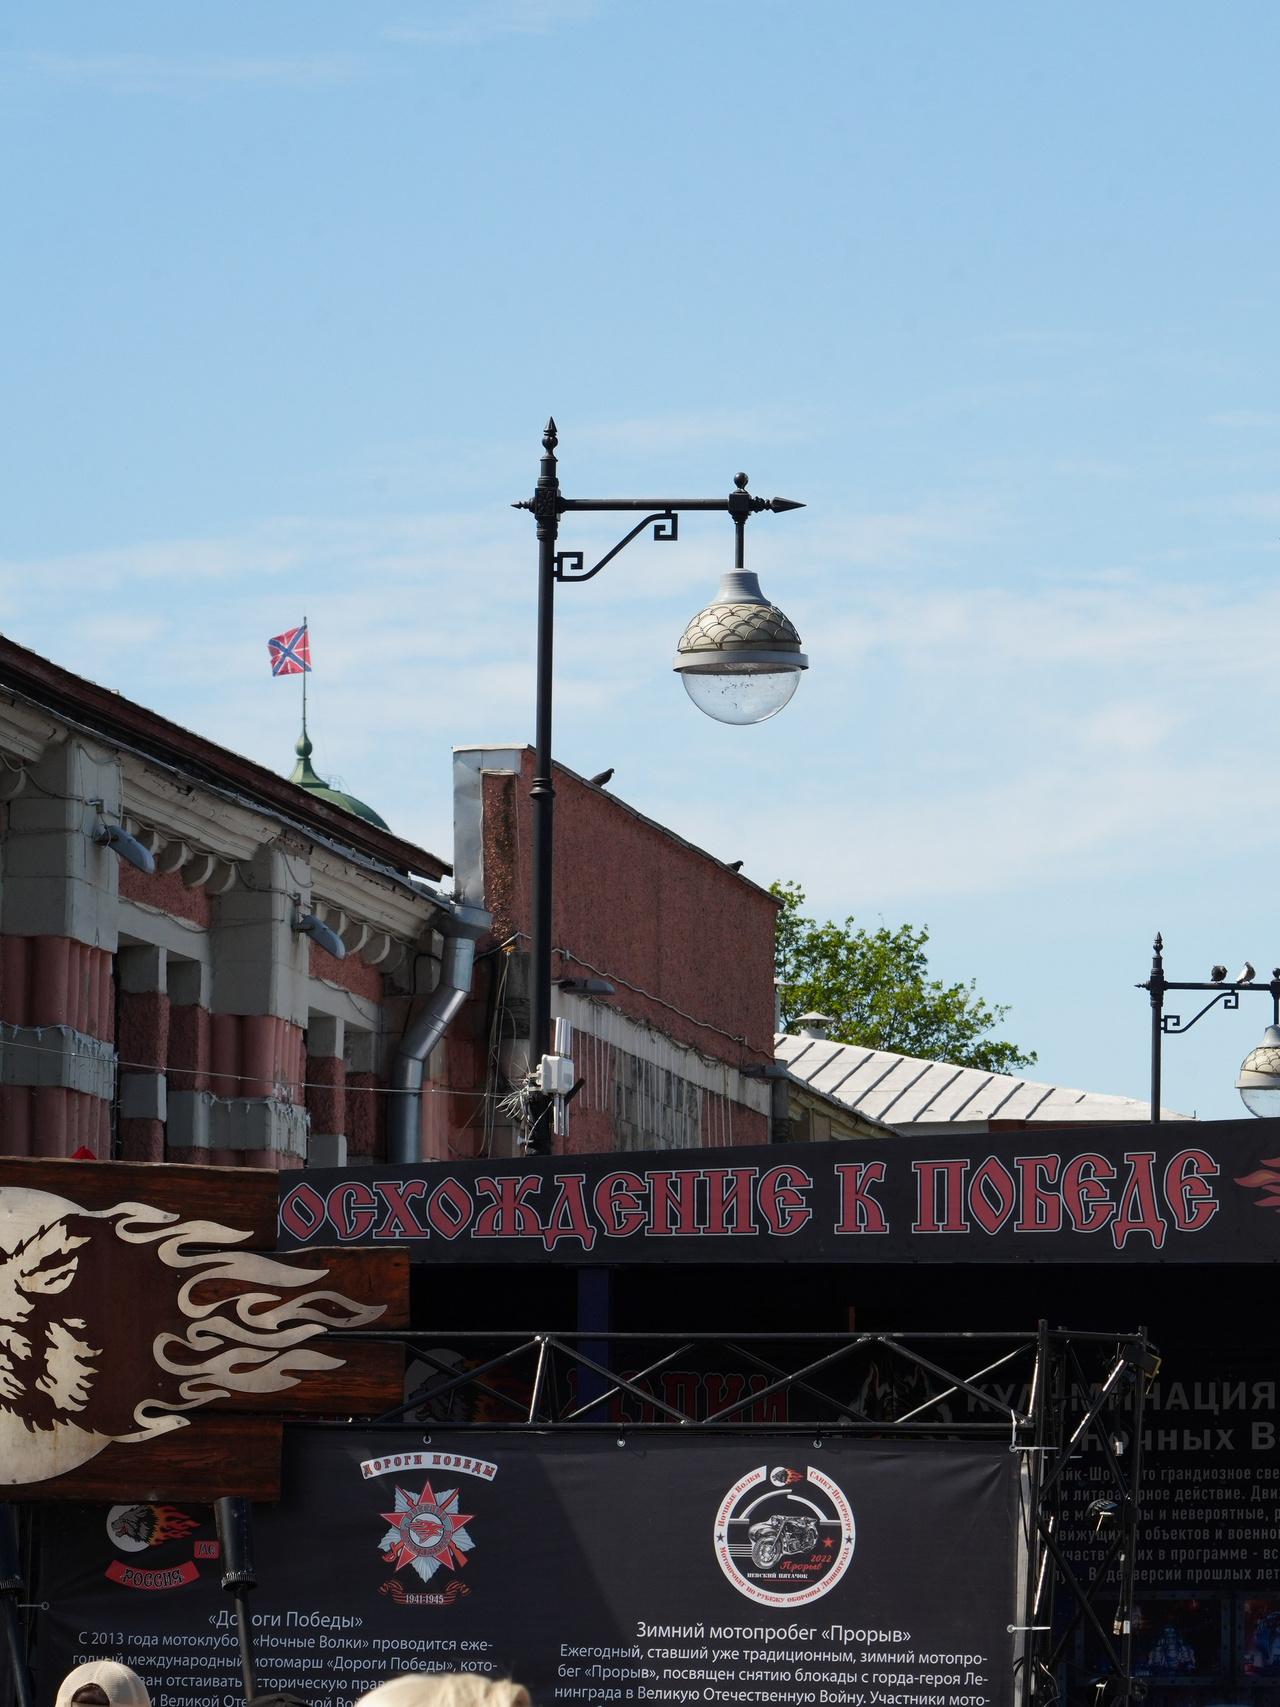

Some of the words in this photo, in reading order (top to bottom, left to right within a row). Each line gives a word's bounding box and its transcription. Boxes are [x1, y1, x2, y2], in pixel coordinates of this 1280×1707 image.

[277, 1163, 813, 1251] ОСХОЖДЕНИЕ
[834, 1161, 890, 1235] К
[911, 1148, 1221, 1250] ПОБЕДЕ
[967, 1381, 1276, 1415] КУЛМИНАЦИЯ
[363, 1454, 423, 1477] ДОРОГИ
[432, 1454, 497, 1477] ПОБЕДЫ
[1160, 1467, 1251, 1482] грандиозное
[1072, 1489, 1170, 1504] литерарное
[1175, 1487, 1246, 1502] действие.
[1159, 1509, 1166, 1520] и
[1172, 1508, 1269, 1522] невероятные,
[1145, 1526, 1210, 1541] объектов
[1215, 1529, 1222, 1540] и
[810, 1554, 832, 1563] 2022
[1158, 1549, 1166, 1561] в
[1171, 1548, 1248, 1564] программе
[780, 1560, 822, 1571] Прорыв
[120, 1568, 185, 1588] РОССИЯ
[1187, 1568, 1251, 1582] прошлых
[1256, 1568, 1280, 1580] лет
[208, 1610, 281, 1629] «Дооги
[286, 1610, 363, 1630] Победы»
[79, 1632, 87, 1645] С
[91, 1632, 124, 1645] 2013
[128, 1634, 158, 1647] года
[253, 1634, 315, 1649] «Ночные
[320, 1635, 369, 1649] Волки»
[372, 1638, 457, 1652] проводится
[460, 1639, 493, 1651] еже-
[636, 1621, 705, 1639] Зимний
[709, 1624, 817, 1643] мотопробег
[821, 1625, 912, 1646] «Прорыв»
[128, 1654, 243, 1669] международный
[327, 1656, 387, 1671] «Дороги
[460, 1660, 498, 1672] кото-
[560, 1643, 643, 1660] Ежегодный,
[647, 1646, 708, 1659] ставший
[712, 1648, 739, 1663] уже
[743, 1649, 856, 1664] традиционным,
[860, 1650, 915, 1664] зимний
[918, 1653, 988, 1667] мотопро-
[166, 1676, 243, 1688] отстаивать
[257, 1677, 348, 1692] сторическую
[557, 1664, 582, 1678] бег
[584, 1665, 660, 1681] «Прорыв»,
[663, 1668, 735, 1683] посвящен
[739, 1669, 791, 1682] снятию
[795, 1668, 858, 1685] блокады
[861, 1672, 869, 1683] с
[872, 1673, 961, 1688] горда-героя
[964, 1672, 989, 1686] Ле-
[160, 1694, 219, 1707] Великой
[554, 1687, 622, 1701] нинграда
[626, 1688, 634, 1698] в
[637, 1686, 700, 1703] Великую
[703, 1687, 816, 1706] Отечественную
[819, 1689, 867, 1707] Войну.
[870, 1691, 945, 1706] Участники
[949, 1695, 990, 1707] мото-
